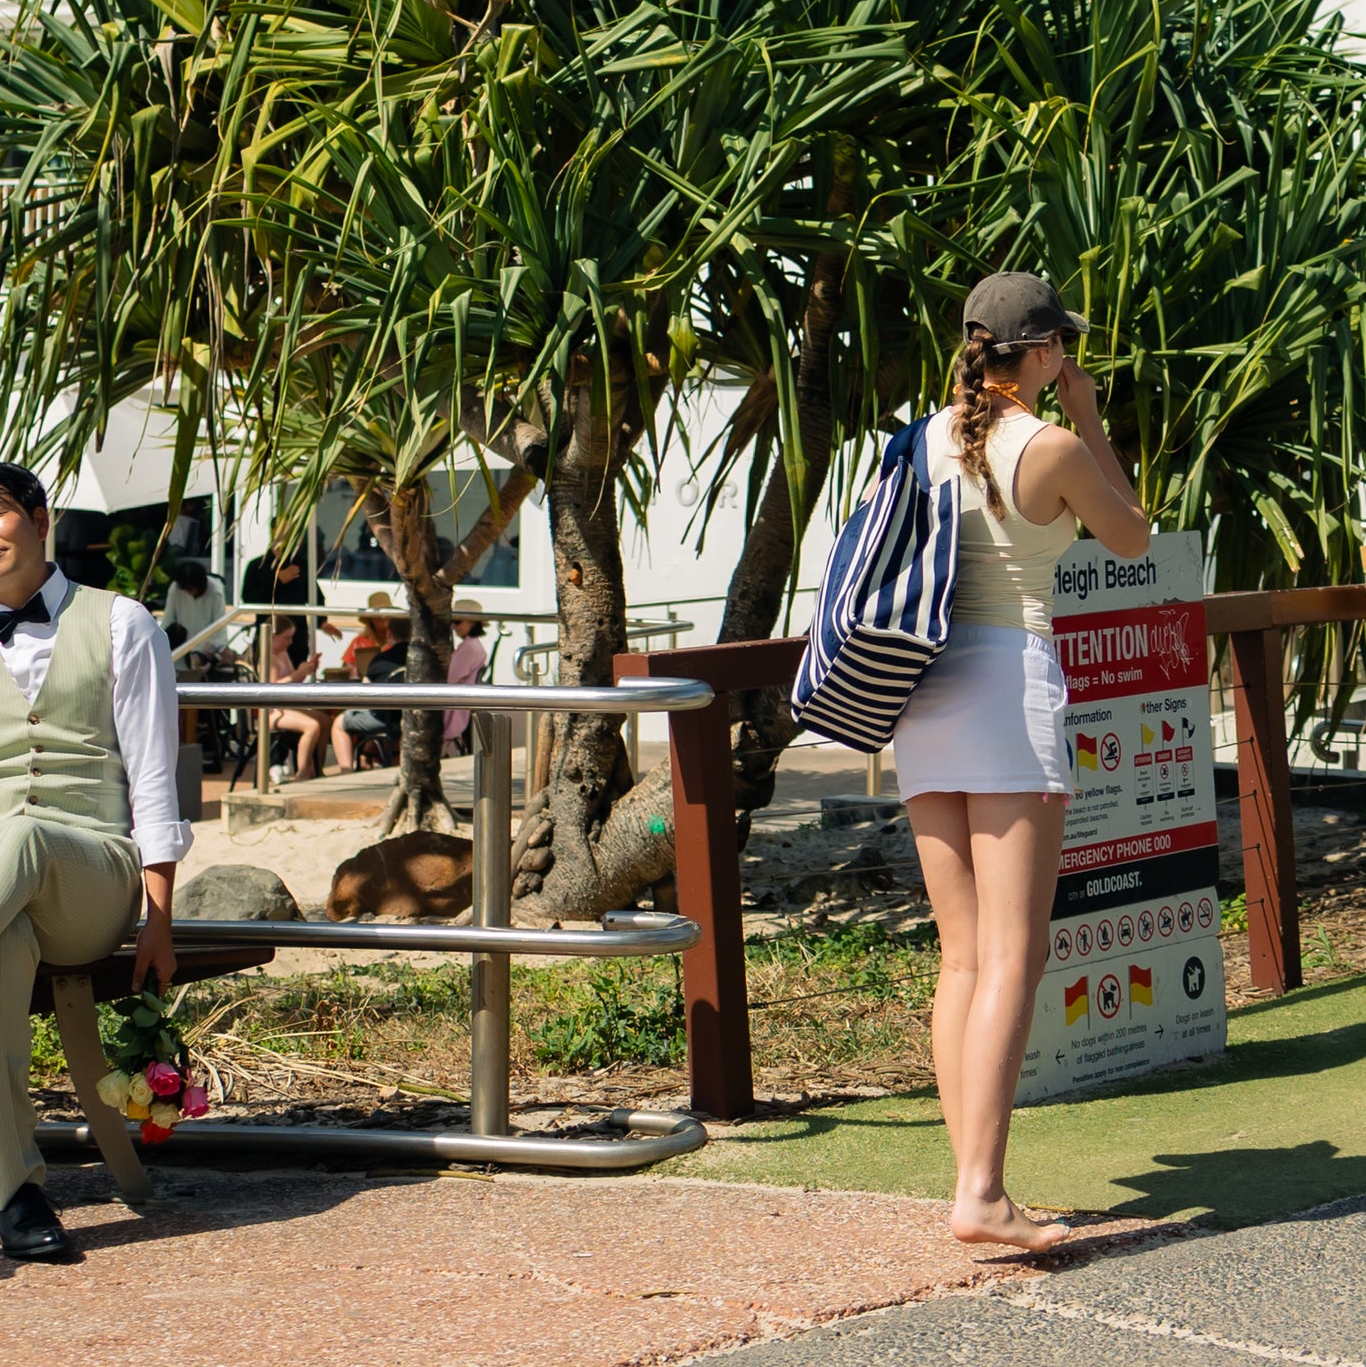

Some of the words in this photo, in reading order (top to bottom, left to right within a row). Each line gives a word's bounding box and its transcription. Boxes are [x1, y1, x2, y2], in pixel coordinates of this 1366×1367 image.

[1052, 561, 1099, 601] leigh
[1105, 556, 1156, 589] Beach
[1053, 623, 1149, 667] TTENTION
[1101, 670, 1115, 685] No
[1117, 667, 1143, 683] swim
[1143, 700, 1162, 714] ther
[1164, 698, 1187, 713] Signs
[1058, 845, 1115, 870] MERGENCY
[1117, 837, 1153, 859] PHONE
[1154, 834, 1171, 850] 000
[1175, 1012, 1191, 1025] Dogs
[1071, 1039, 1080, 1050] No
[1081, 1036, 1096, 1048] dogs
[1115, 1027, 1127, 1039] 200
